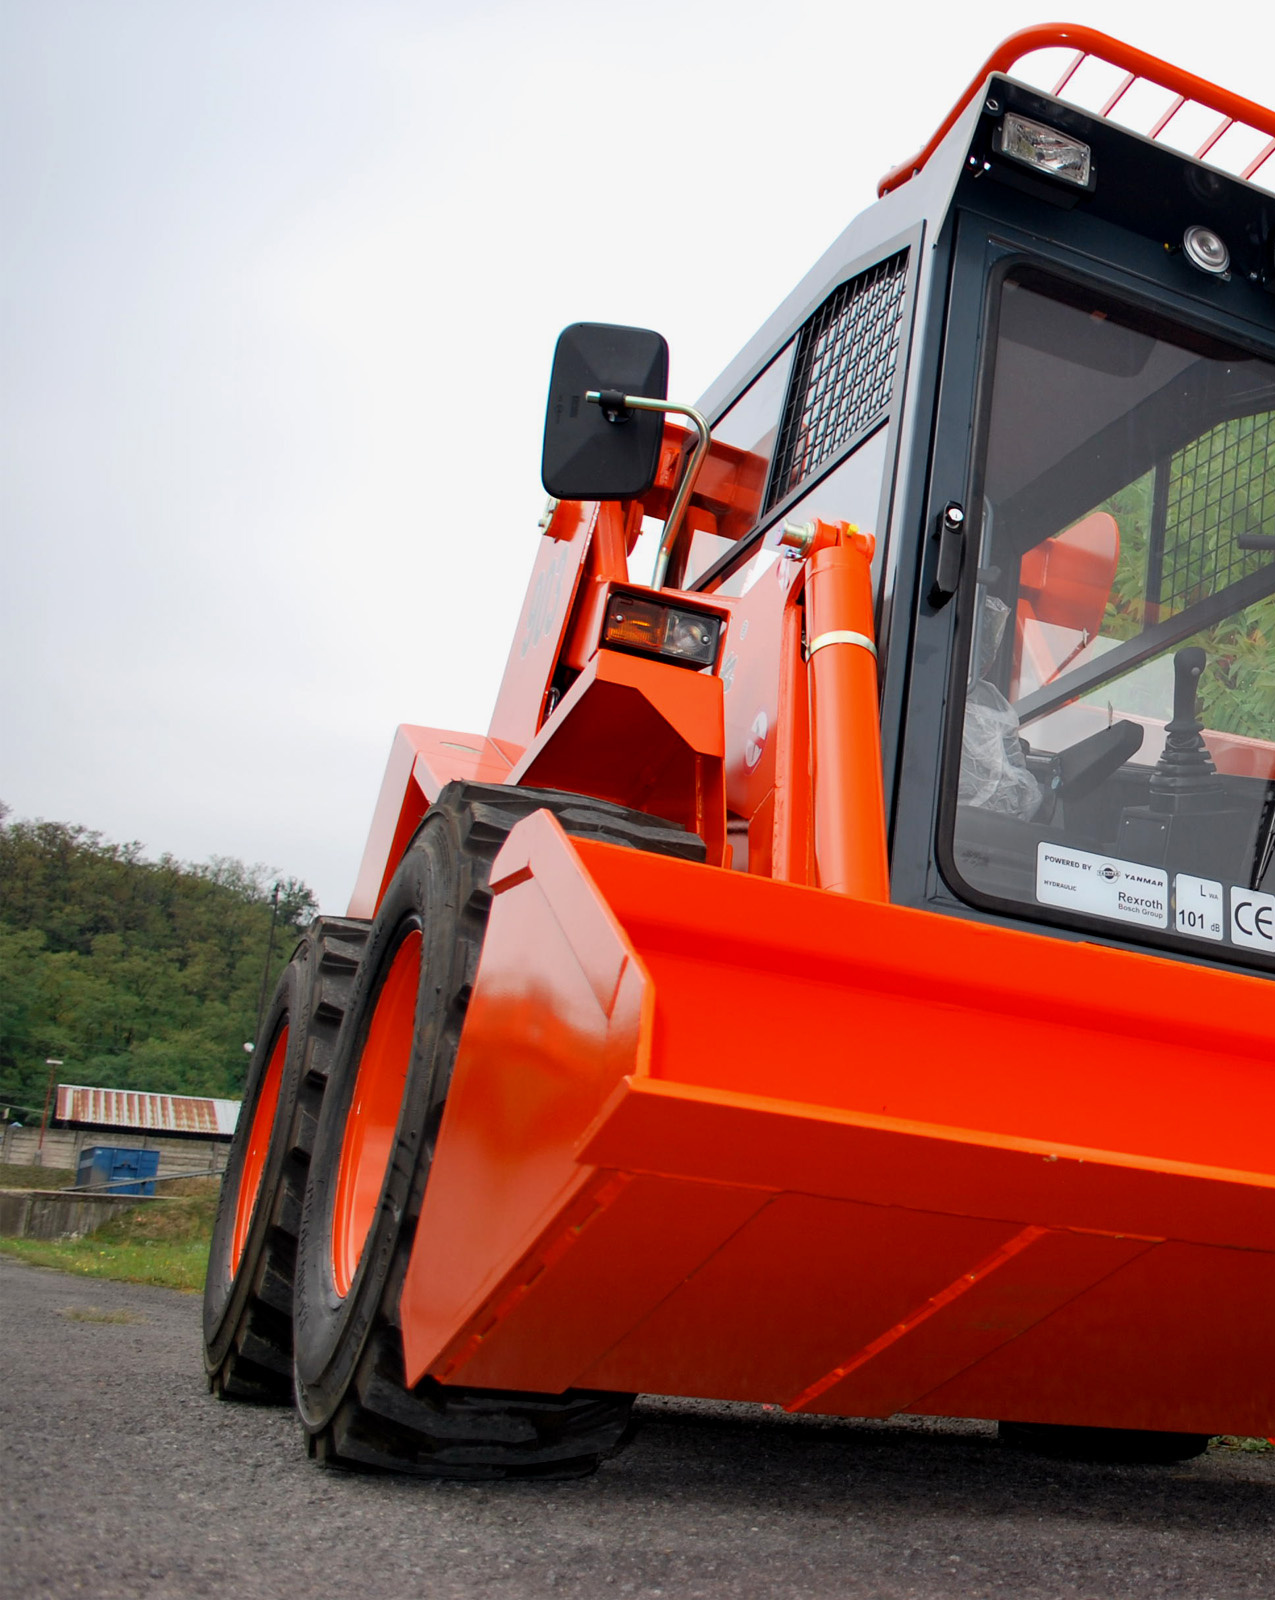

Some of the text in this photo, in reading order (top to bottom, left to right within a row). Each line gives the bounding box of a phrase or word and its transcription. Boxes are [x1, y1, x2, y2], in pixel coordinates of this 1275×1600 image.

[1044, 854, 1092, 871] POWERED BY
[1043, 879, 1077, 892] HYDRAULIC
[1124, 873, 1164, 887] YANMAR
[1199, 884, 1207, 898] L
[1118, 891, 1163, 911] Rexroth
[1118, 903, 1163, 920] Bosch Group
[1178, 909, 1220, 933] 101 dB
[1234, 901, 1273, 940] CE
